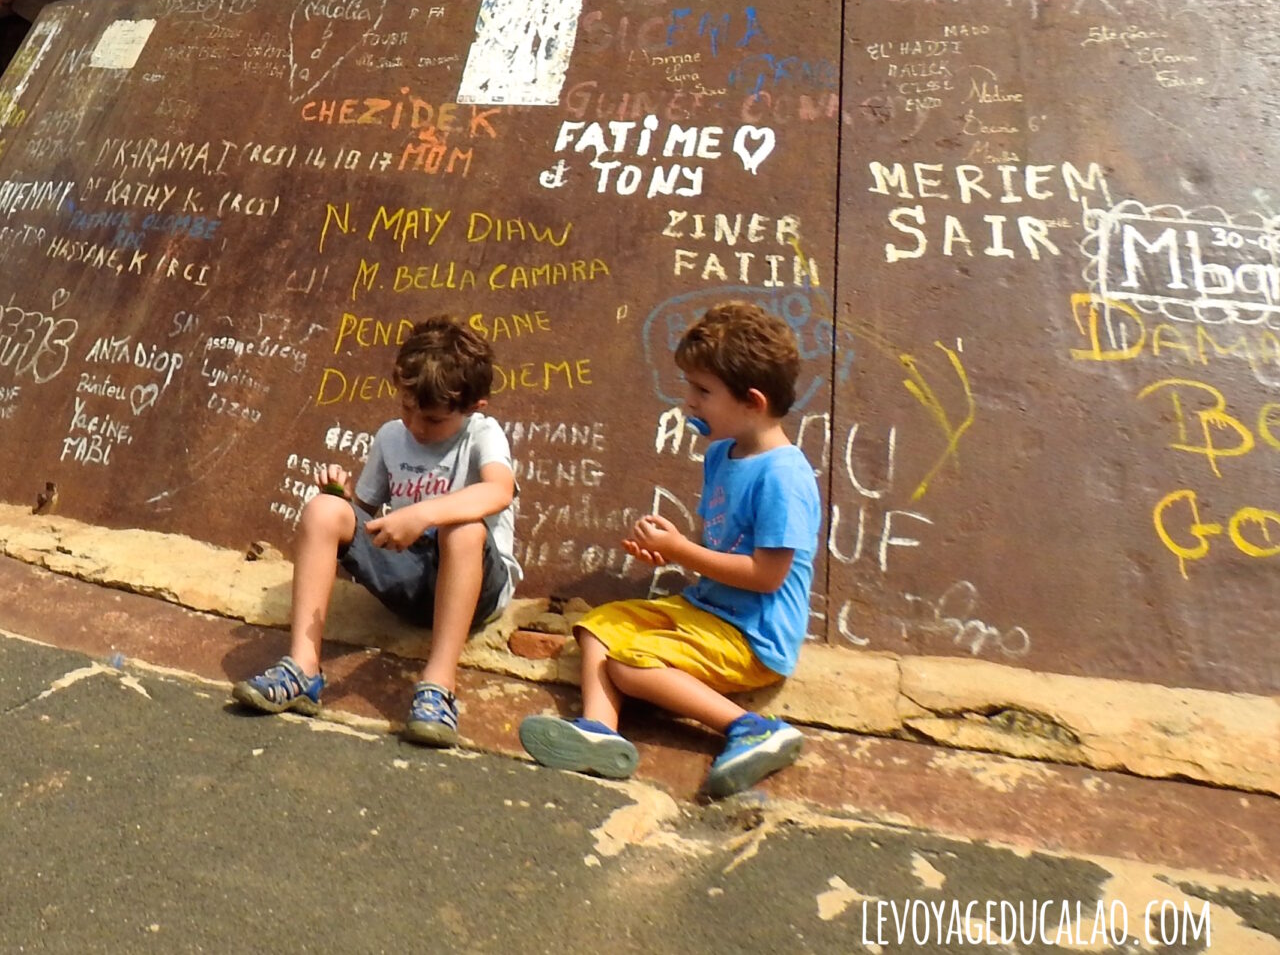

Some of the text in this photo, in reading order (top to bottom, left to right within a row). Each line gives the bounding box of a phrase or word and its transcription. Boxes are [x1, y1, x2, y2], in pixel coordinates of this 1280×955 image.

[589, 157, 703, 199] TONY
[868, 161, 1114, 207] MERIEM
[467, 211, 573, 248] DIAW
[884, 204, 1063, 263] SAIR
[393, 262, 477, 293] BELLA
[487, 257, 611, 292] CAMARA
